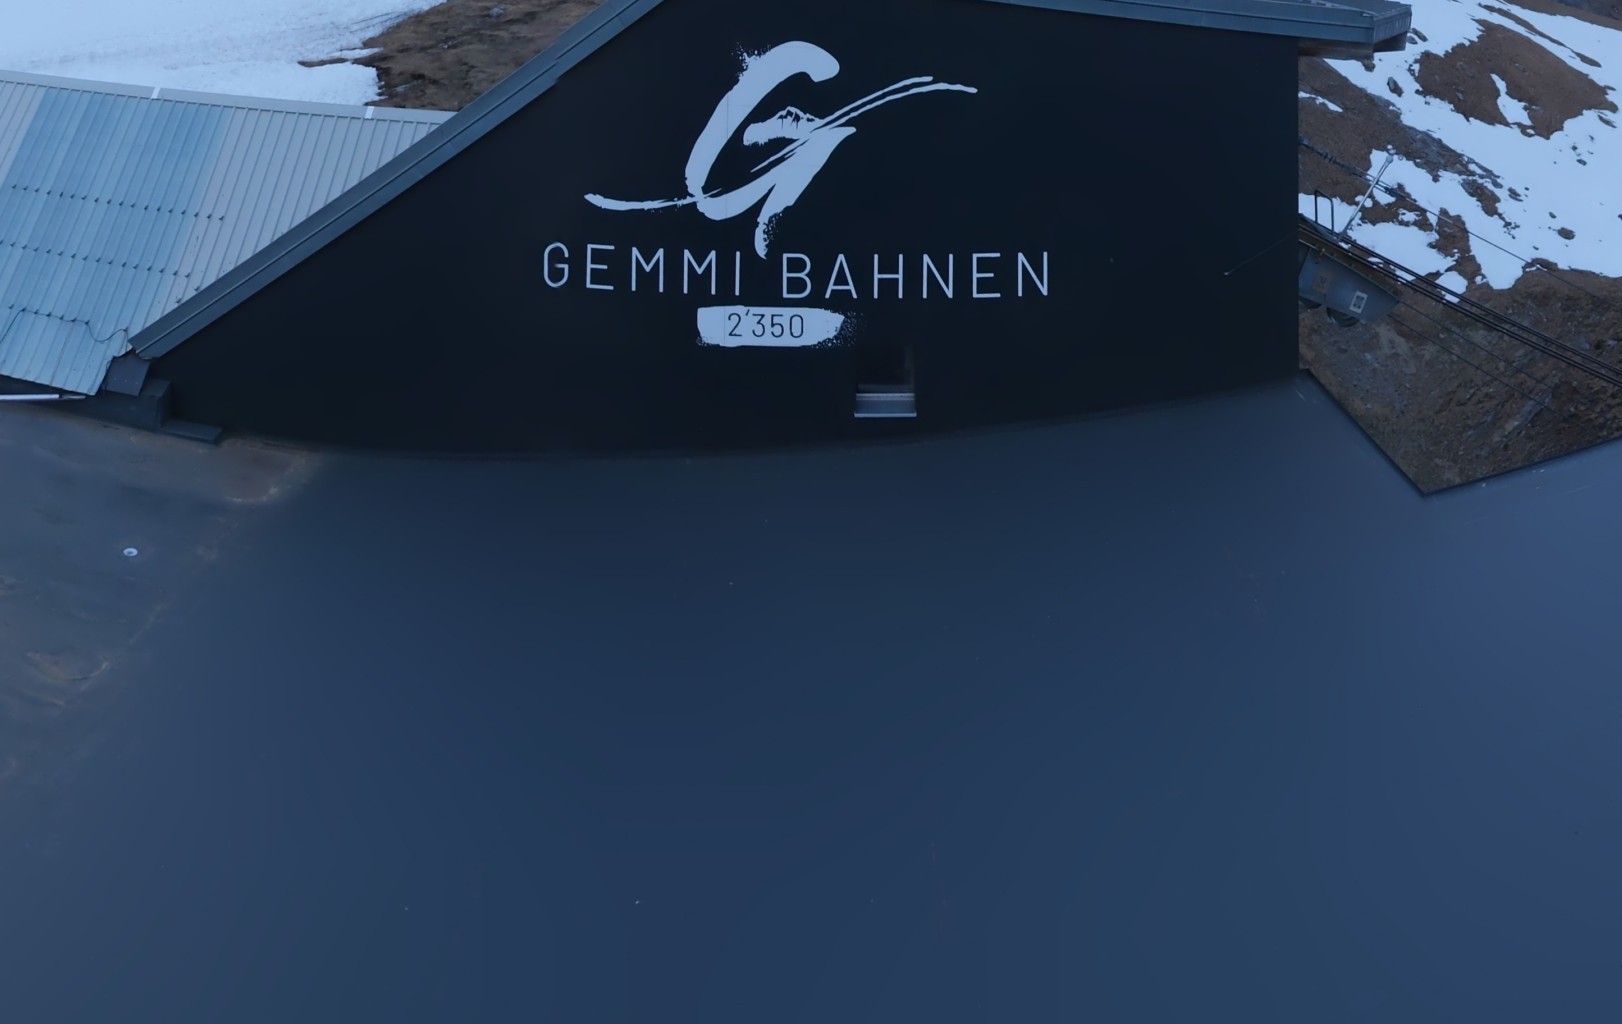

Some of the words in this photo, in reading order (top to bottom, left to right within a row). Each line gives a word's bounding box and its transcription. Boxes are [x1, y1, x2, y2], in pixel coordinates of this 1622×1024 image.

[543, 242, 742, 296] GEMMI
[782, 252, 1049, 299] BAHNEN
[728, 309, 804, 339] 2'350
